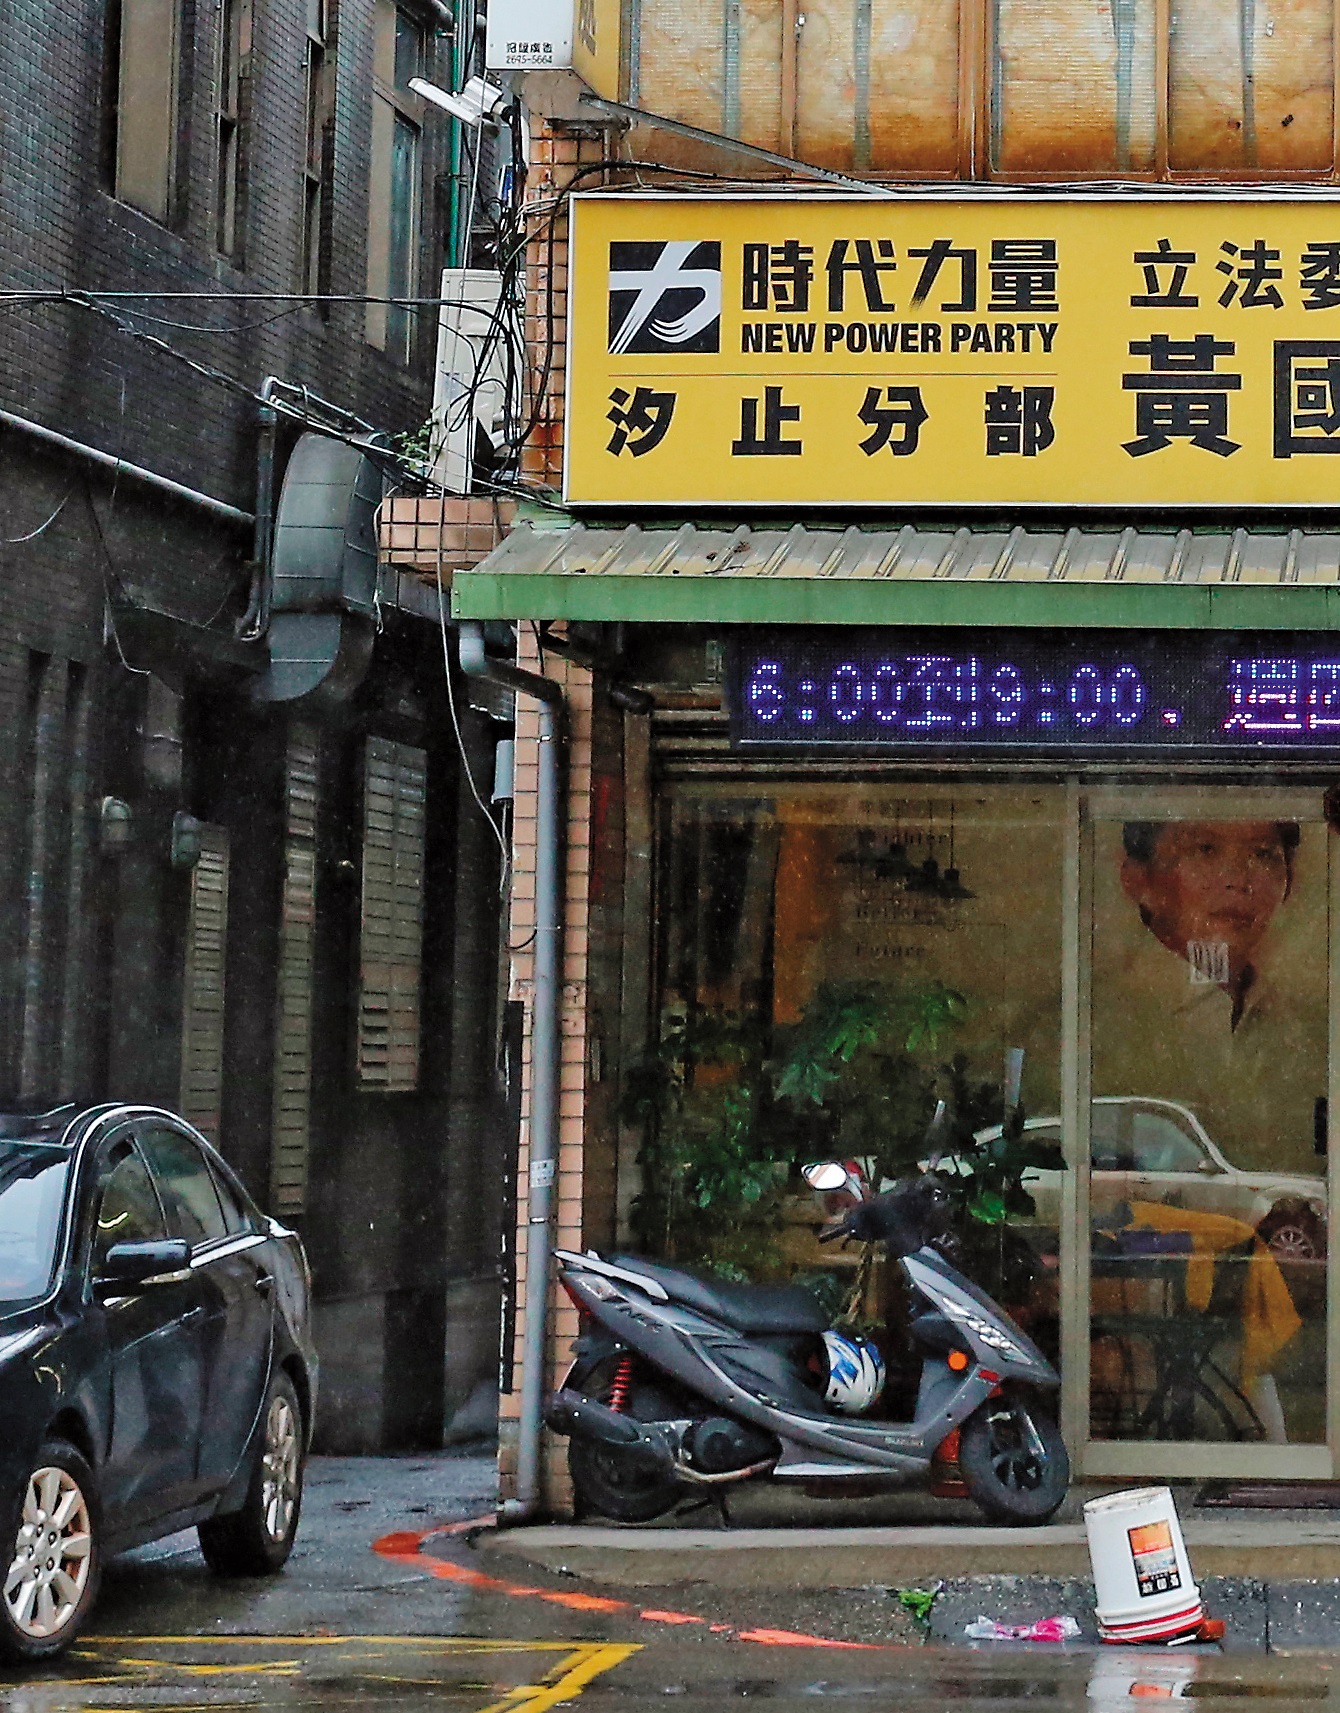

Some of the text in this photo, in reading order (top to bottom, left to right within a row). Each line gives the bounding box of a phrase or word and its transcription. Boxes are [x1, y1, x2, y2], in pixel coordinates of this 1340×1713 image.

[742, 239, 1060, 313] 時代力量
[741, 322, 1059, 354] NEW POWER PARTY
[605, 385, 1056, 458] 汐止分部
